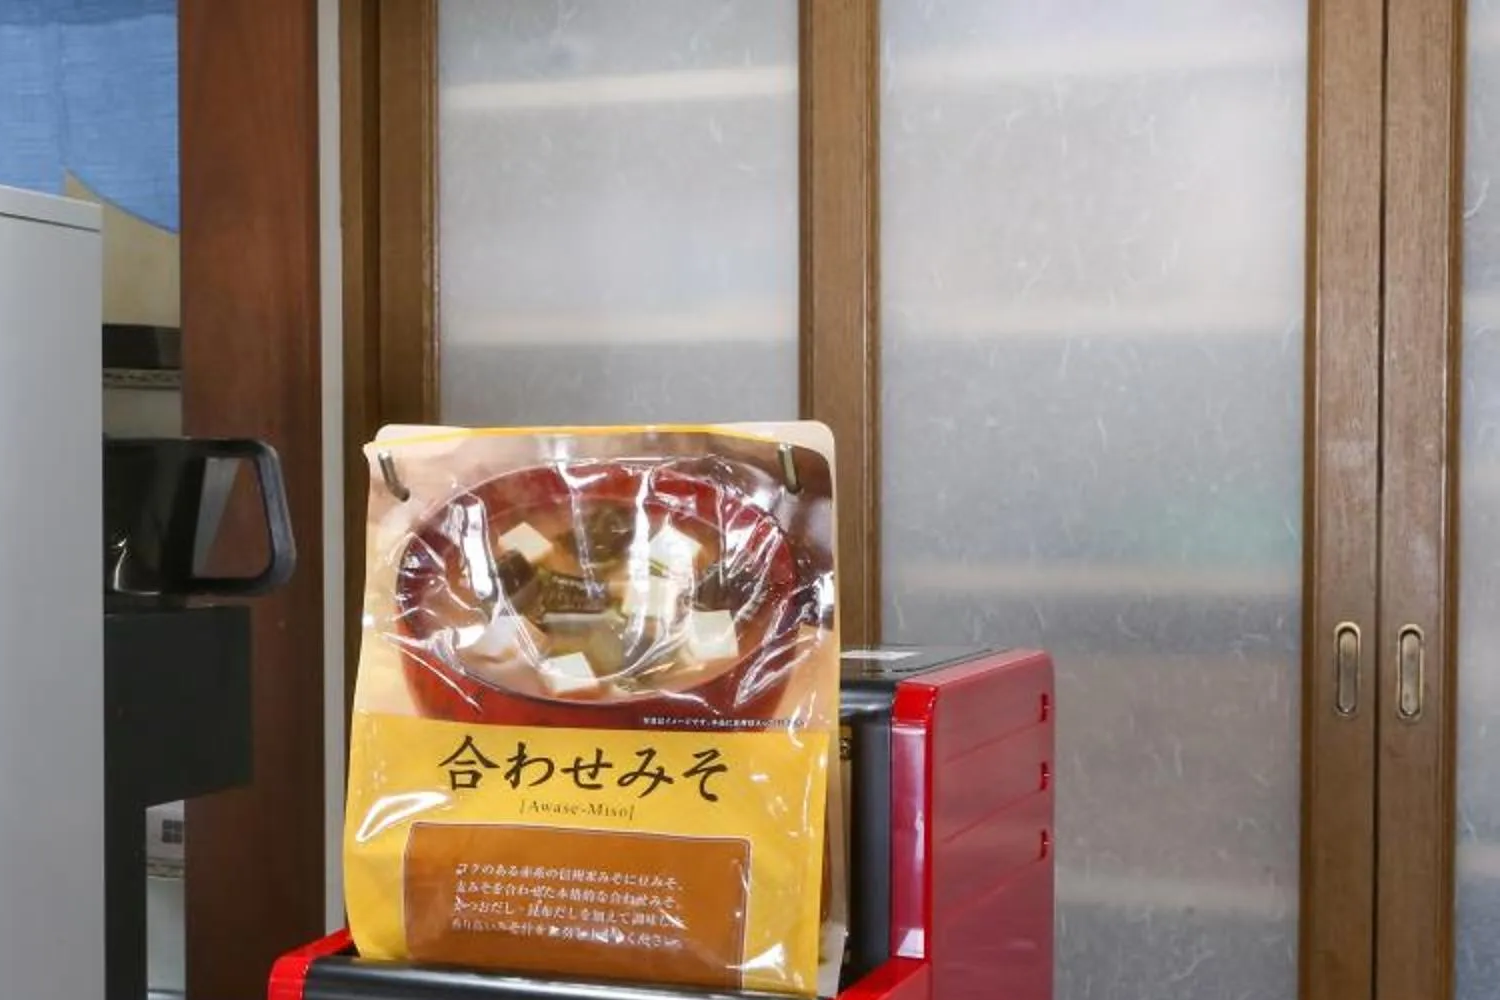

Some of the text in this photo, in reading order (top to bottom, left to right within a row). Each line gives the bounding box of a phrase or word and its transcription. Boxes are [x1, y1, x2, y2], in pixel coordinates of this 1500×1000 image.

[438, 734, 729, 802] 合わせみそ
